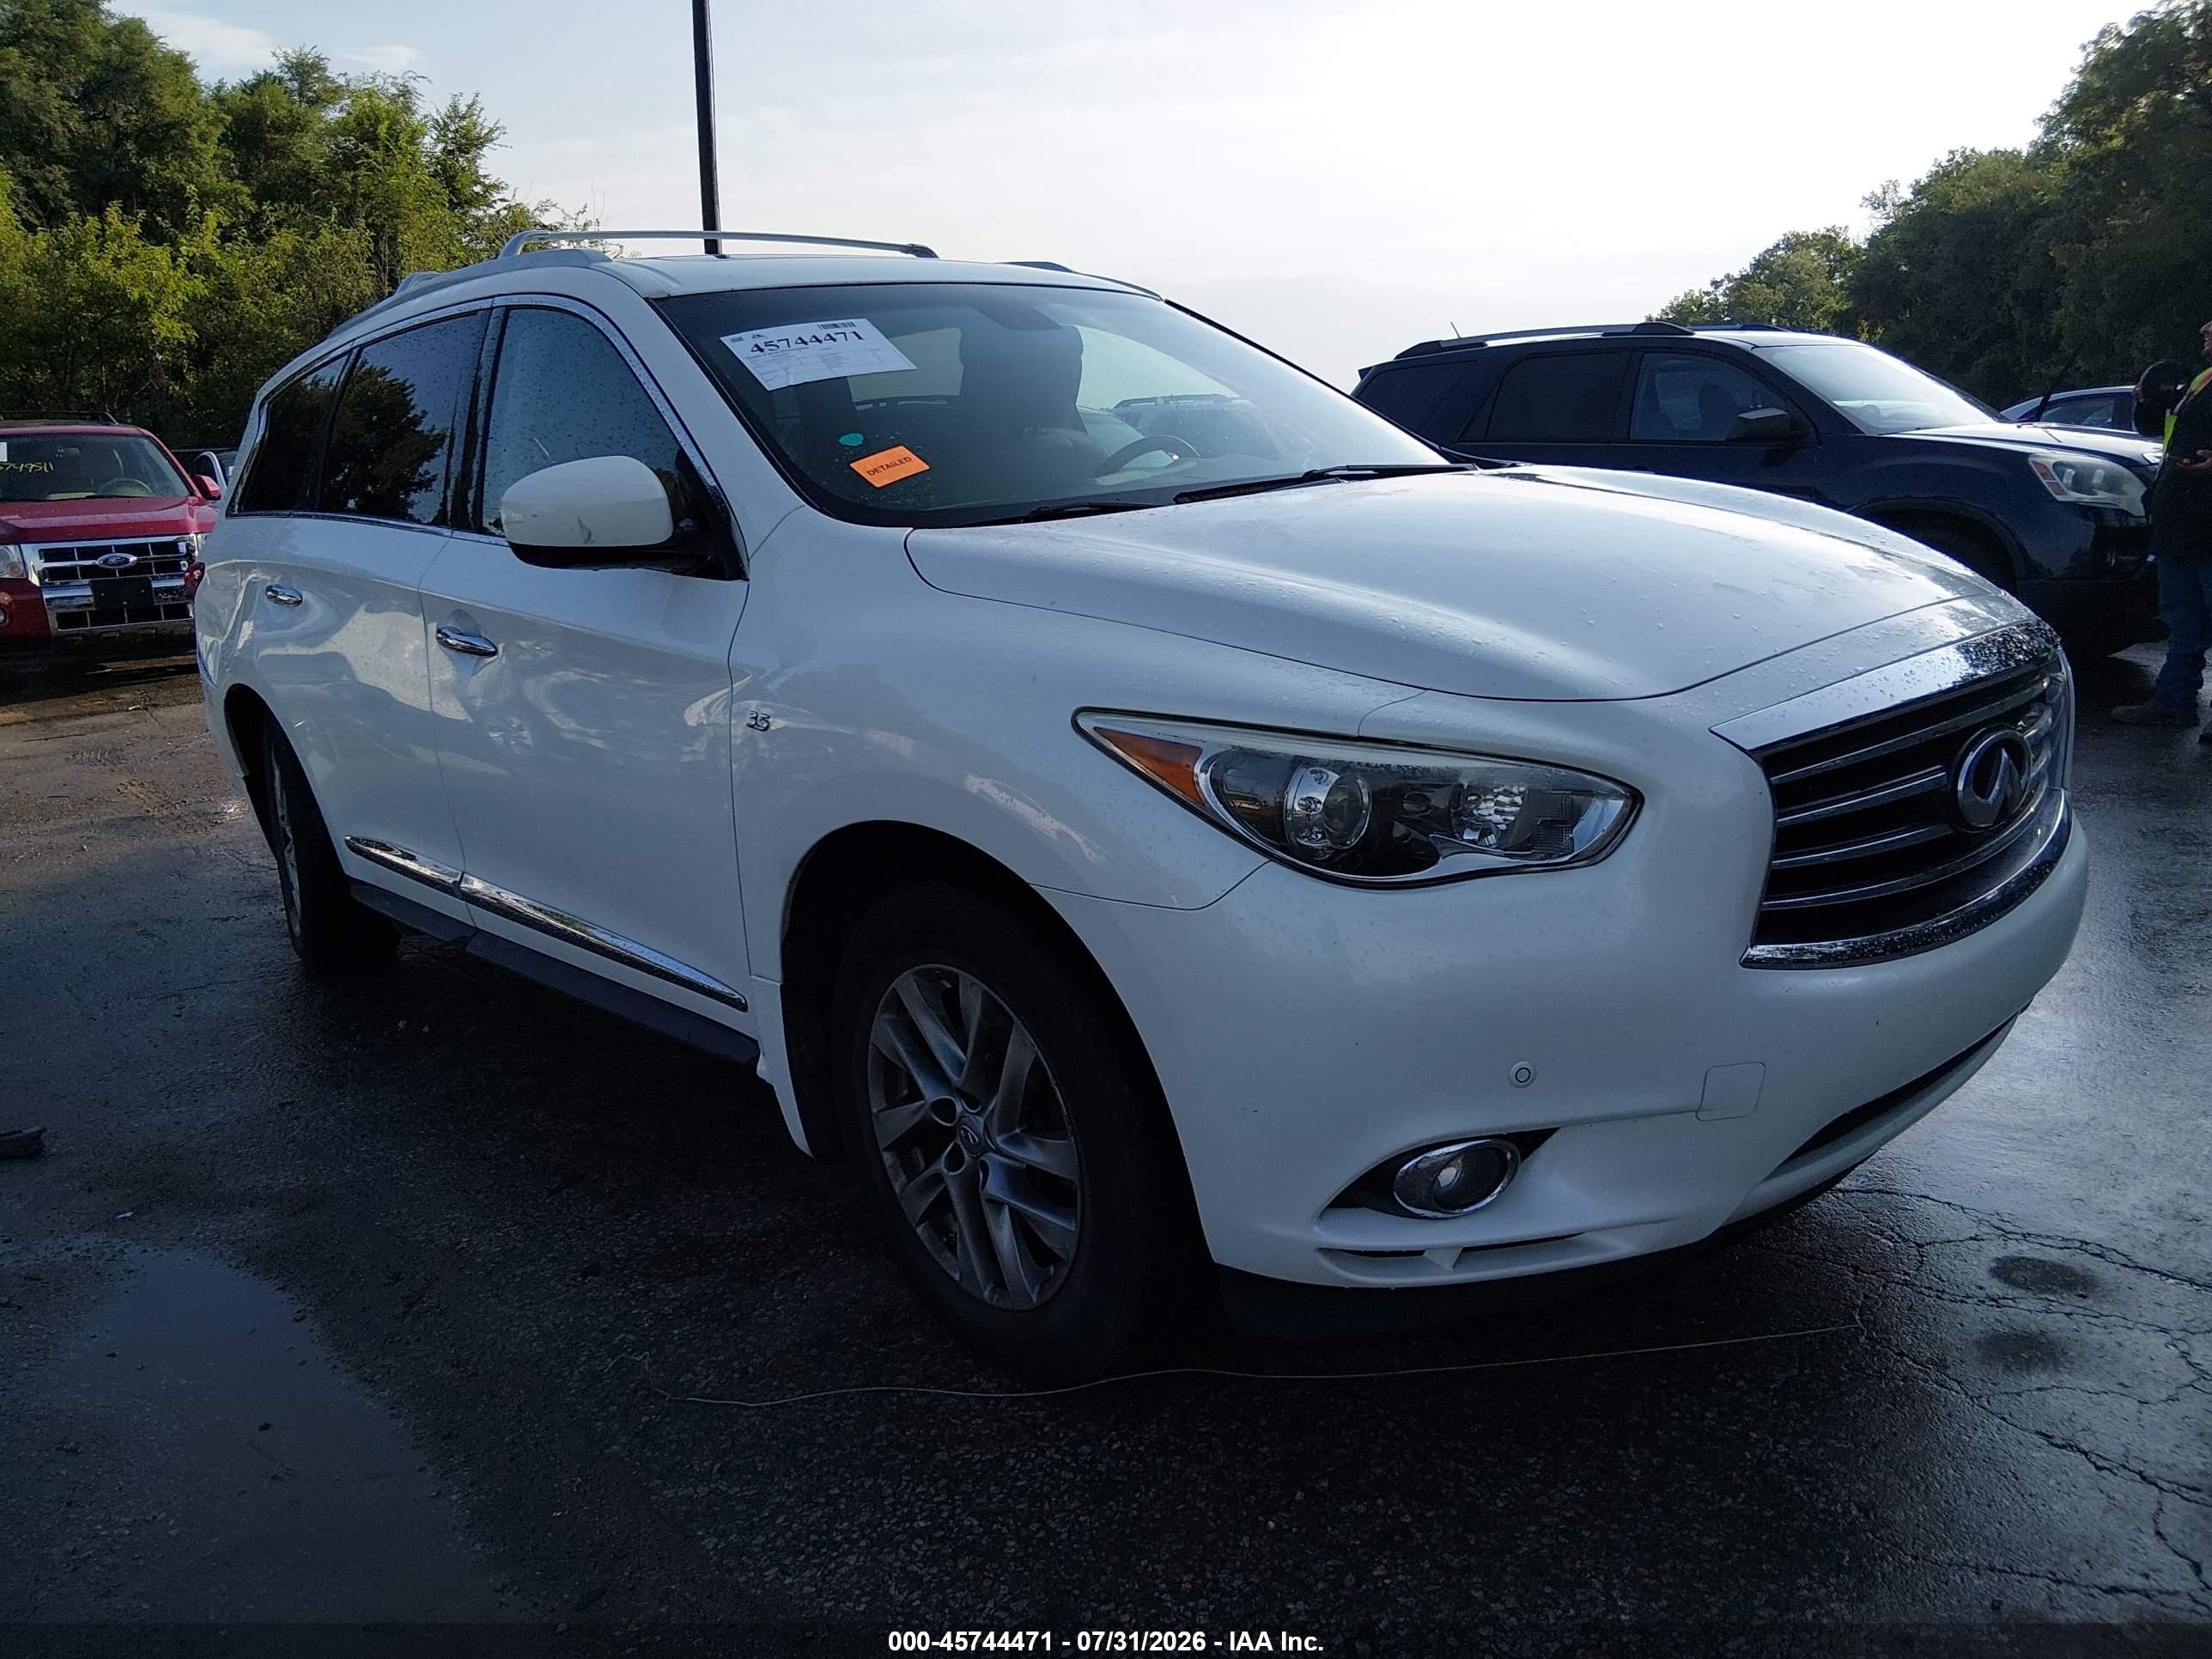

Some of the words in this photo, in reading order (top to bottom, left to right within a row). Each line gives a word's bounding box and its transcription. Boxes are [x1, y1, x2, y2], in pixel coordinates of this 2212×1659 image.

[750, 331, 866, 353] 45744471
[866, 456, 912, 476] DETAILED
[745, 710, 770, 732] 35
